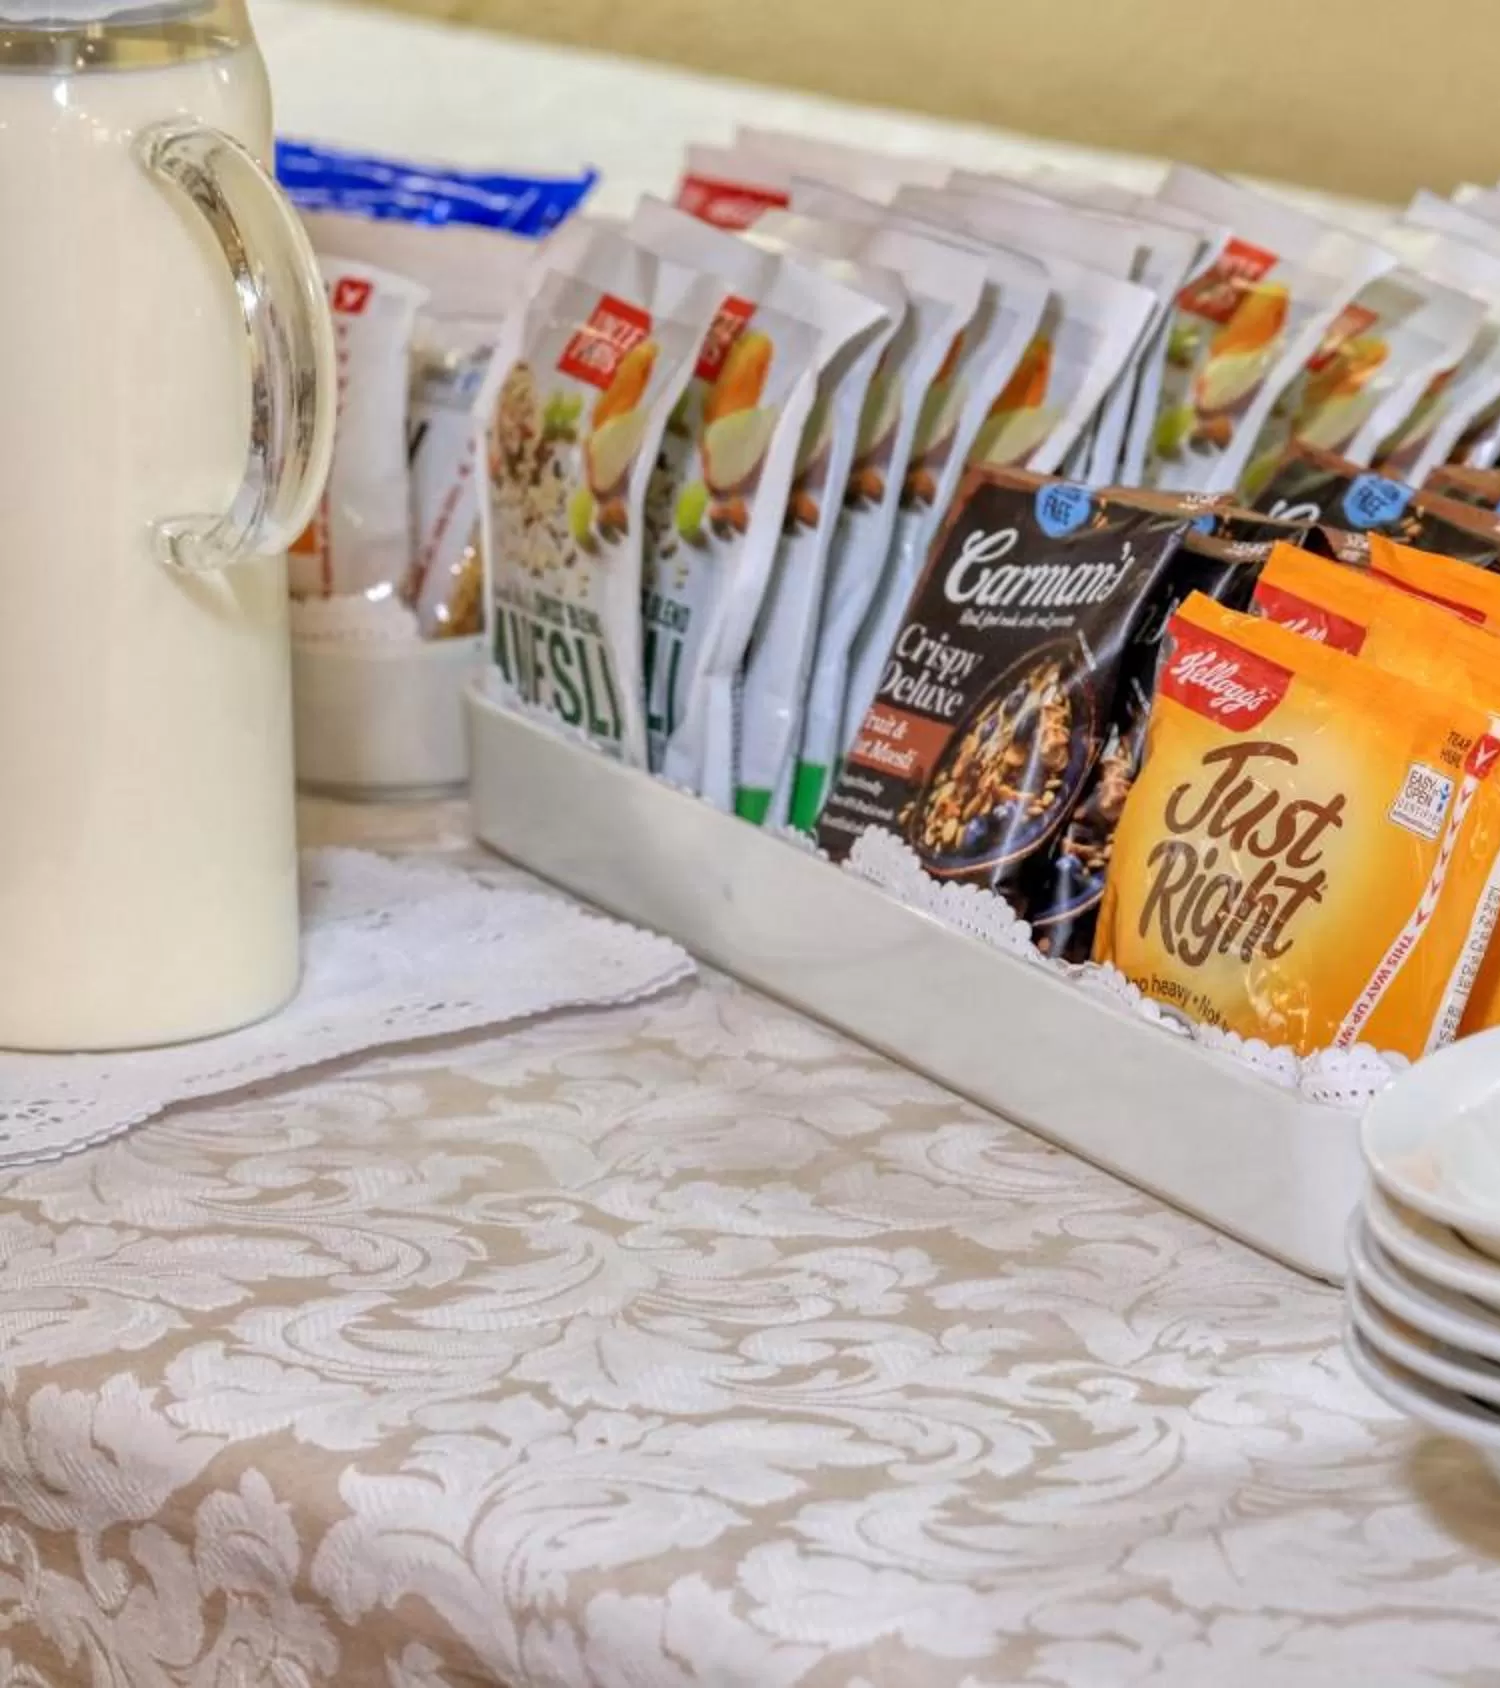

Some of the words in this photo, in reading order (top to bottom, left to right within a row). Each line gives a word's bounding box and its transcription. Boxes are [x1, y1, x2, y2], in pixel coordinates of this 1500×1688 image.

[944, 528, 1135, 607] Carman's
[897, 623, 984, 686] Crispy
[1170, 651, 1269, 714] Kellogg's
[1164, 741, 1347, 868] Just
[1138, 839, 1327, 967] Right
[1387, 935, 1415, 966] THIS
[1151, 973, 1192, 1006] heavy
[1352, 1003, 1370, 1025] UP
[1365, 969, 1392, 1000] WAY
